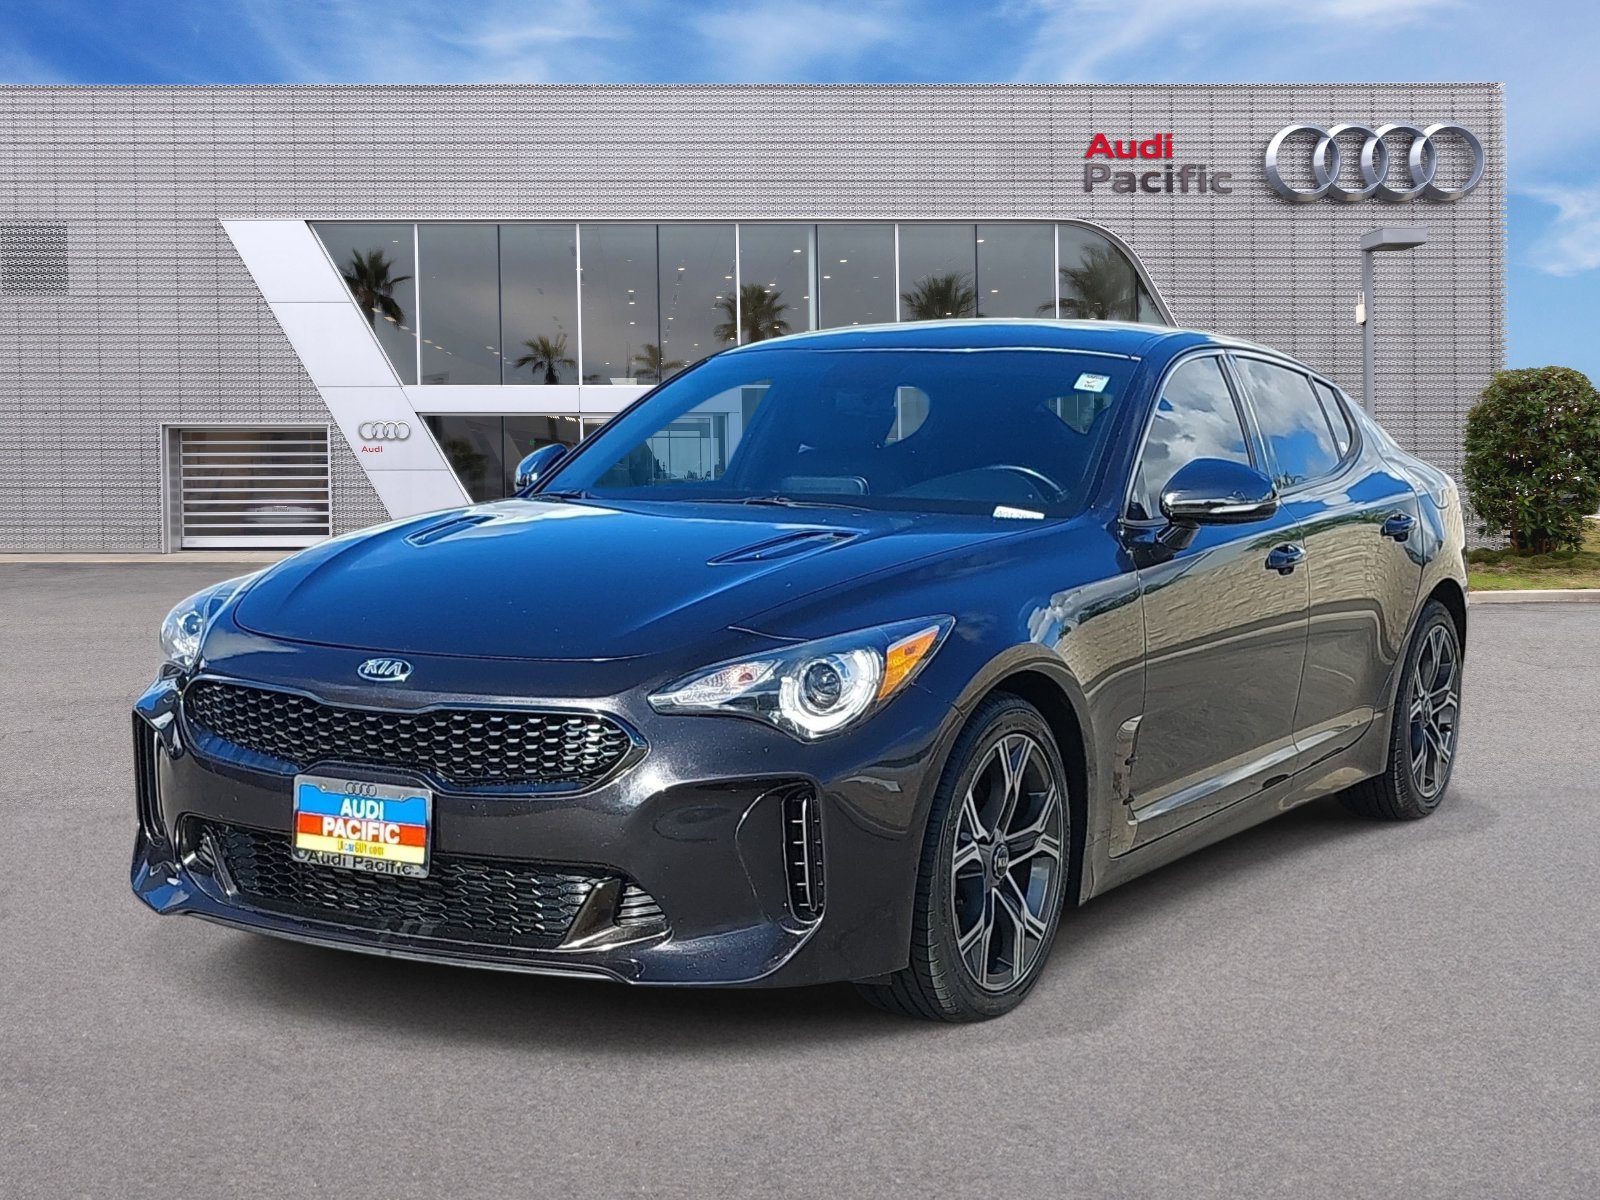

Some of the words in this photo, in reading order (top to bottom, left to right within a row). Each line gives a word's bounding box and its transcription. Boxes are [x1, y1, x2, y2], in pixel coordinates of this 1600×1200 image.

[1084, 132, 1174, 159] Audi
[1084, 163, 1233, 194] Pacific
[361, 445, 384, 453] Audi
[363, 659, 403, 676] KIA
[339, 798, 385, 821] AUDI
[322, 815, 401, 844] PACIFIC
[307, 849, 347, 868] Audi
